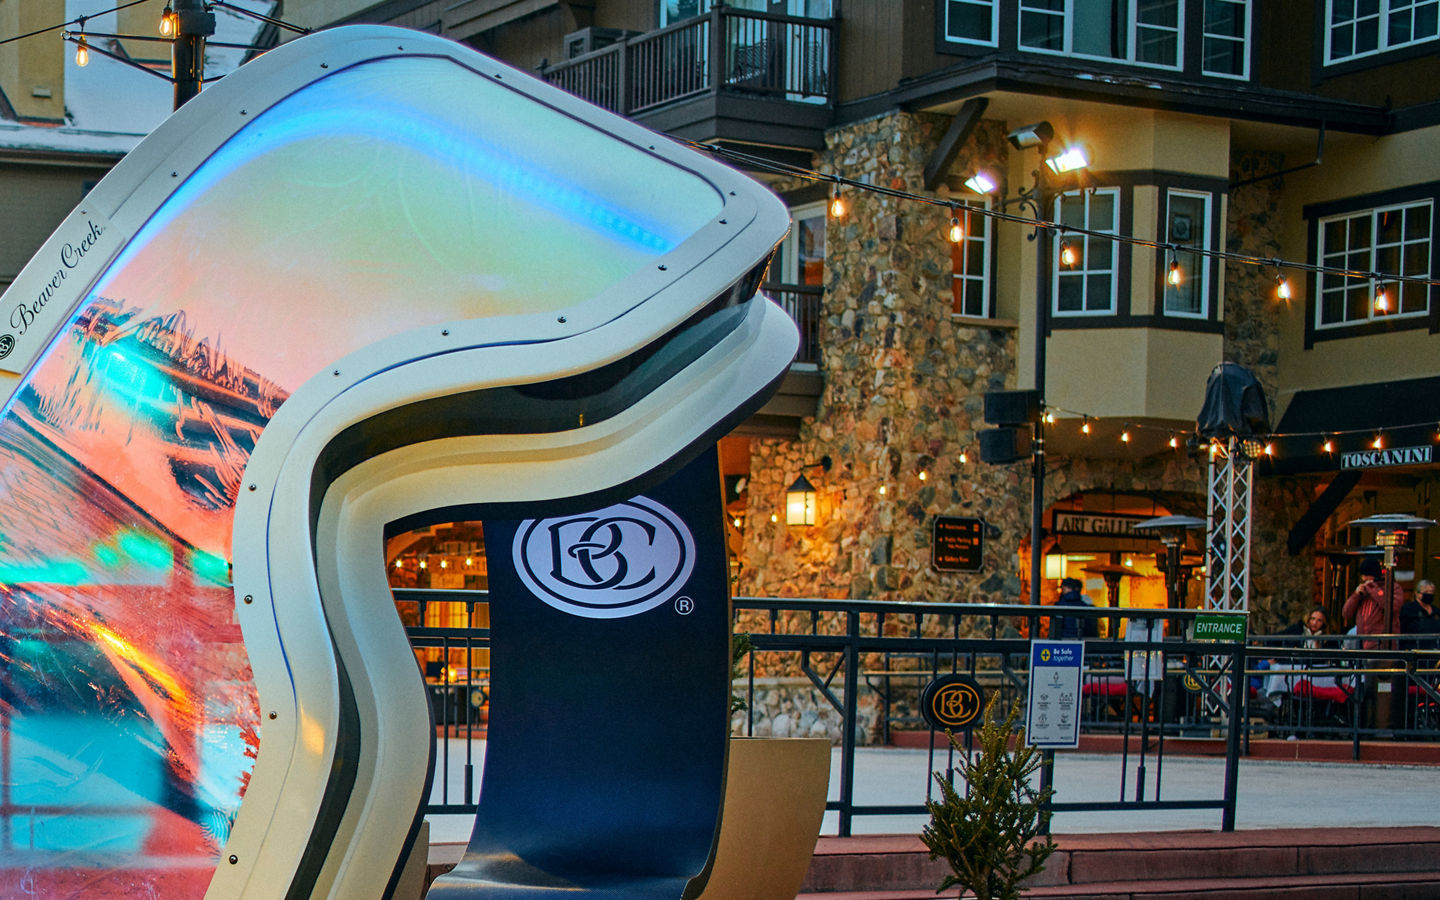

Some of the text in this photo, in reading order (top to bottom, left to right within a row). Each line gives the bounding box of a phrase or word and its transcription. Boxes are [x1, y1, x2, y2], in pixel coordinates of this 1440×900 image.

[10, 269, 67, 335] Beaver
[61, 220, 103, 269] Creek
[1342, 447, 1430, 468] TOSCANINI
[1062, 516, 1088, 532] ART
[1196, 622, 1242, 634] ENTRANCE
[1061, 647, 1072, 655] Safe
